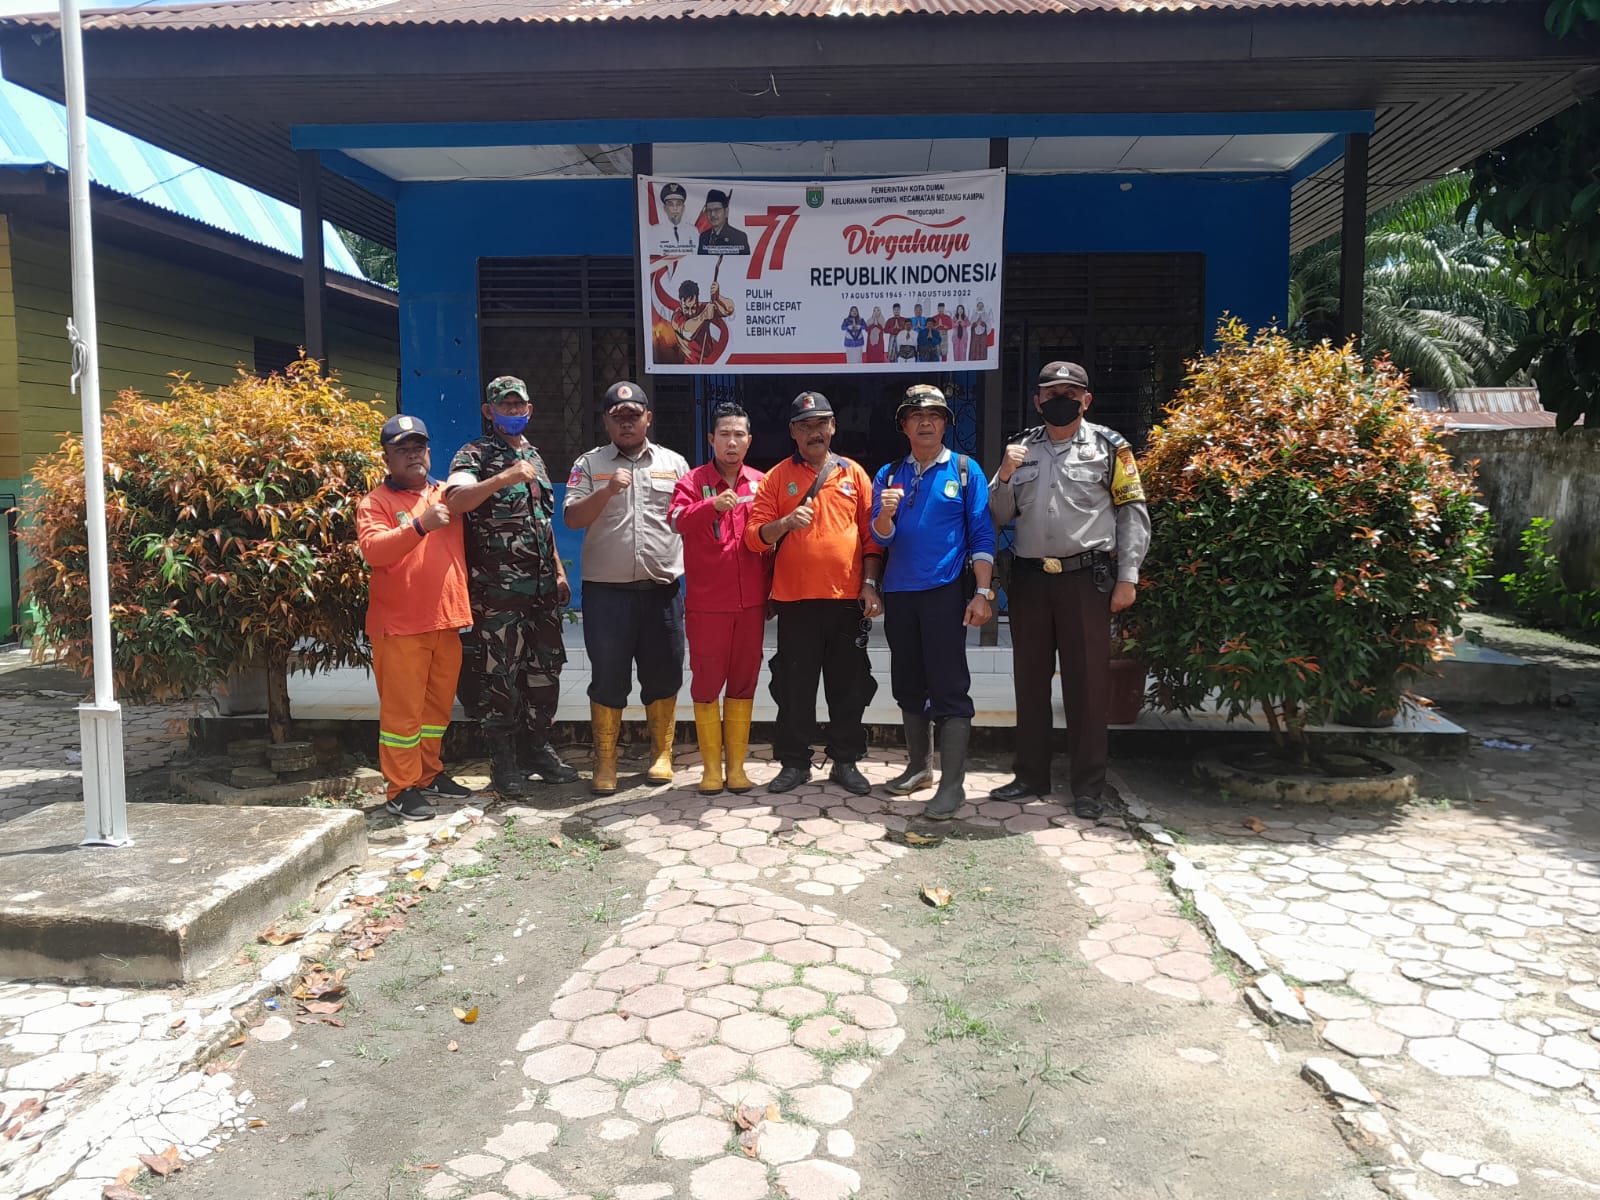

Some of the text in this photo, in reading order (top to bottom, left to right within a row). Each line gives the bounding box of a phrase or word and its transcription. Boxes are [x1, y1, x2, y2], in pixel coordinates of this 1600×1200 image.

[871, 185, 908, 194] PEMERINTAH
[831, 197, 867, 206] KELURAHAN
[899, 193, 935, 203] KECAMATAN
[936, 193, 961, 202] MEDANG
[962, 192, 985, 201] KAMPAI
[842, 223, 970, 261] Dirgahayu
[810, 265, 897, 287] REPUBLIK
[746, 289, 773, 299] PULIH
[841, 292, 849, 300] 17
[886, 291, 902, 299] 1945
[909, 290, 916, 298] 17
[917, 290, 951, 298] AGUSTUS
[953, 289, 971, 297] 2022
[746, 301, 802, 311] LEBIH CEPAT
[746, 315, 785, 325] BANGKIT
[746, 326, 796, 336] LEBIH KUAT
